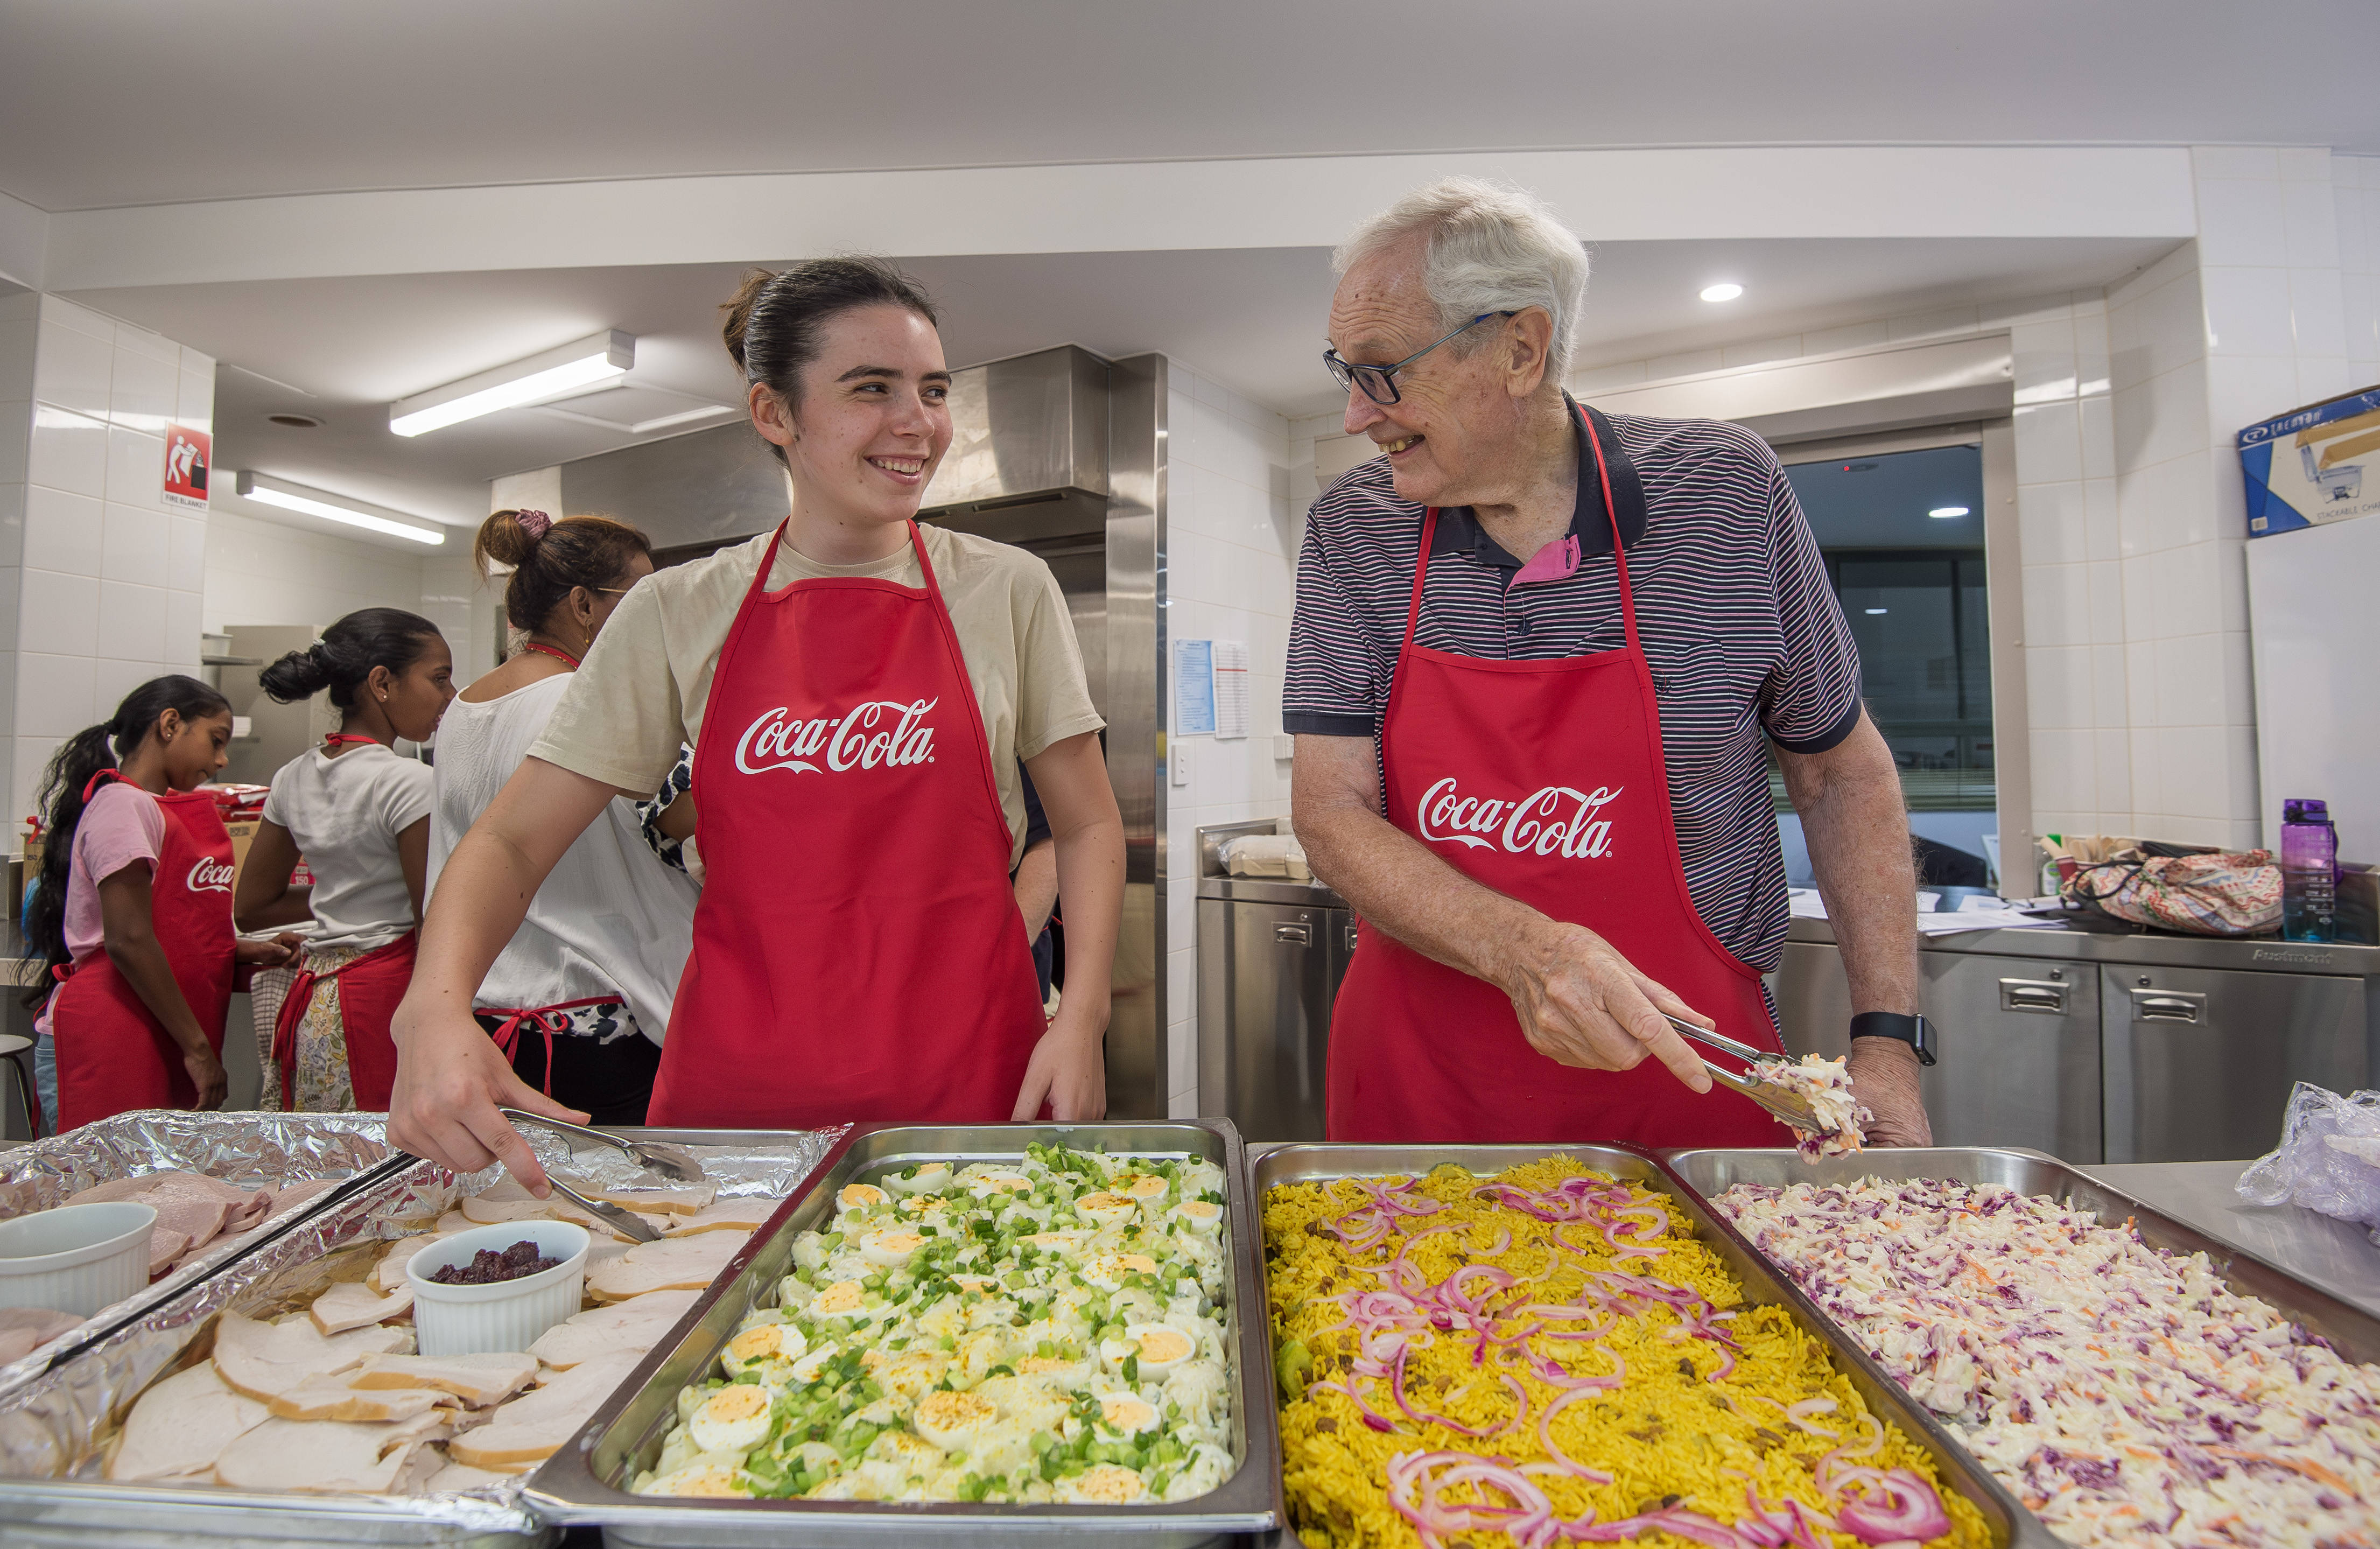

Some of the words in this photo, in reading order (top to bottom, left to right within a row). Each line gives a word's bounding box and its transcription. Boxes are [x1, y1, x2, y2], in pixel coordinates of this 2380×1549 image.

[166, 494, 178, 503] FIRE
[180, 496, 207, 509] BLANKET
[735, 696, 939, 775] Coca-Cola
[1418, 777, 1624, 859] Coca-Cola
